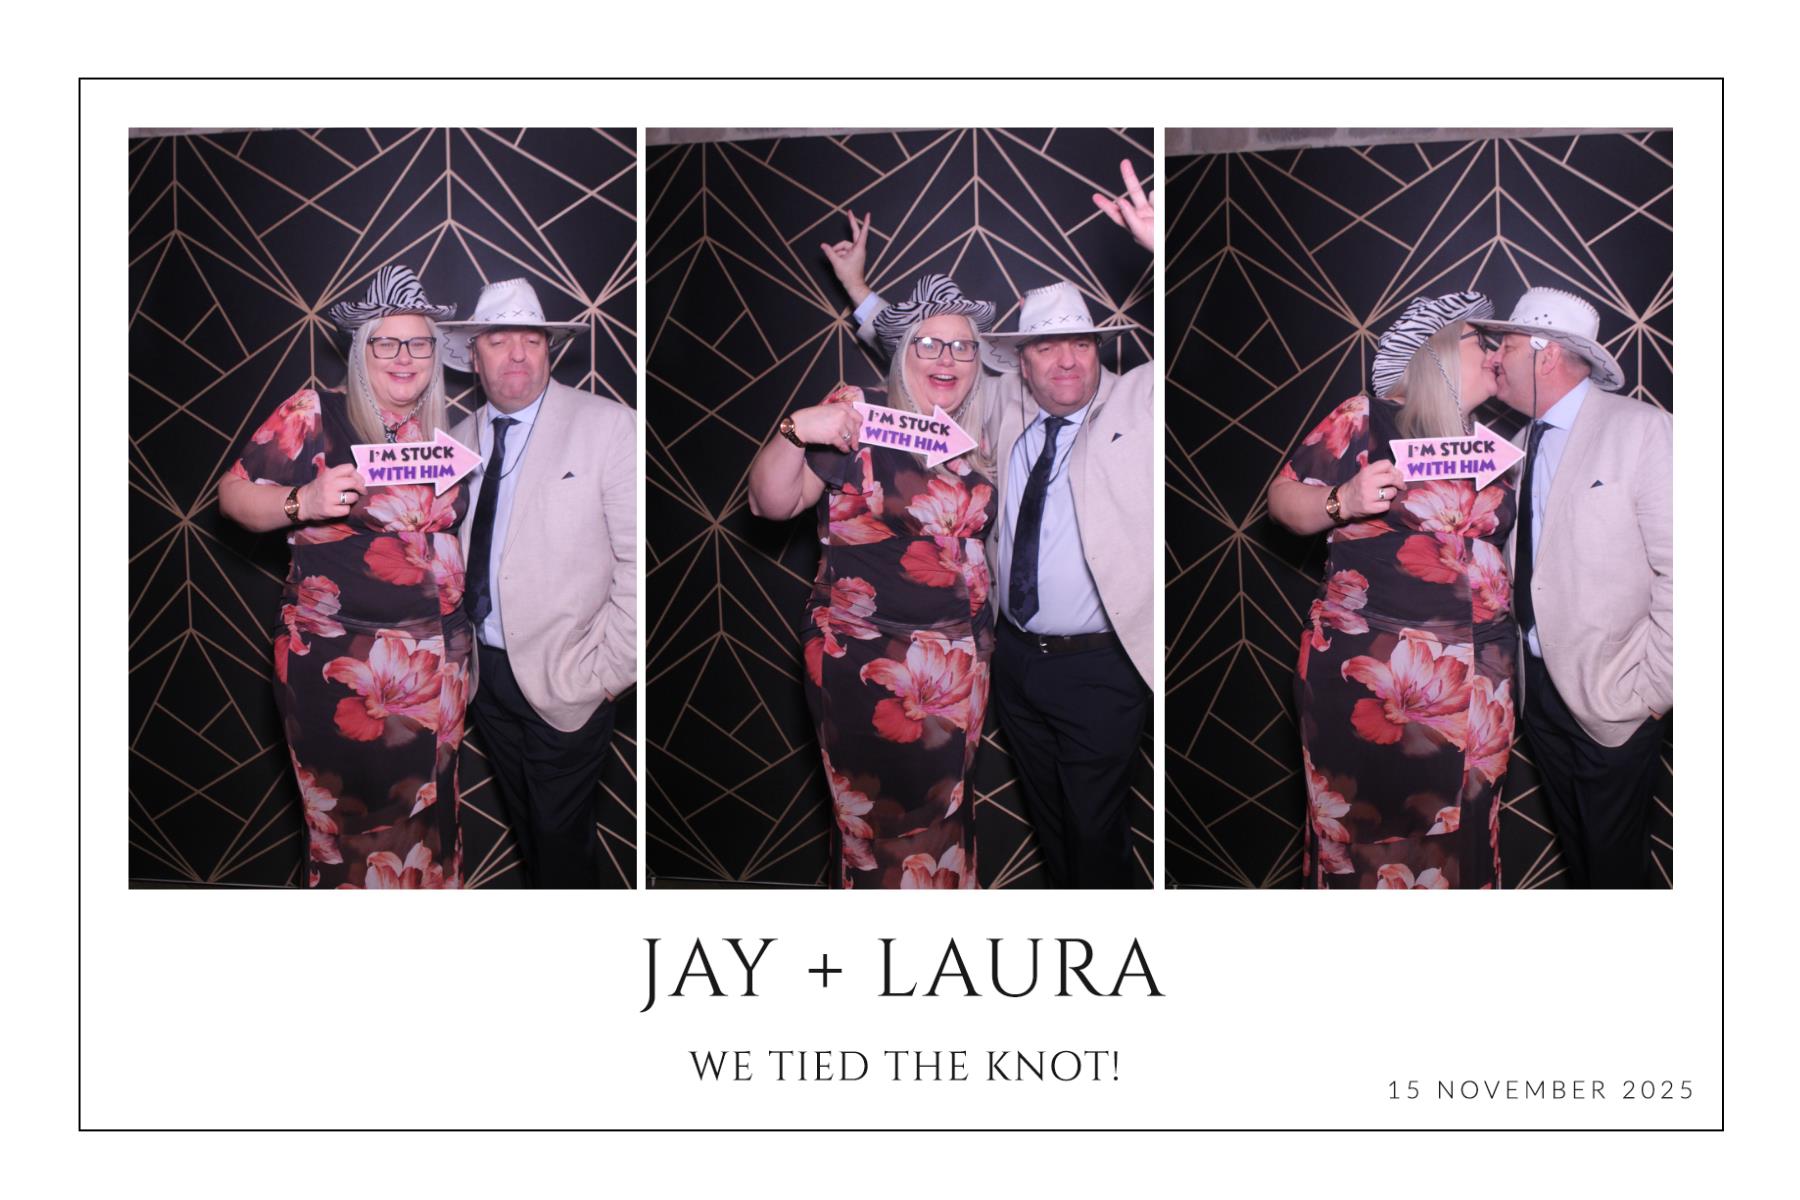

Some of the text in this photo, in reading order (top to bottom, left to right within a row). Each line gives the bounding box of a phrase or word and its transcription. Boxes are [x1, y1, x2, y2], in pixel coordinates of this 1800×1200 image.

[868, 410, 951, 437] I'M STUCK
[865, 426, 949, 453] WITH HIM
[369, 446, 454, 463] I'M STUCK
[1408, 440, 1495, 458] I'M STUCK
[368, 464, 455, 481] WITH HIM
[1407, 459, 1497, 477] WITH HIM
